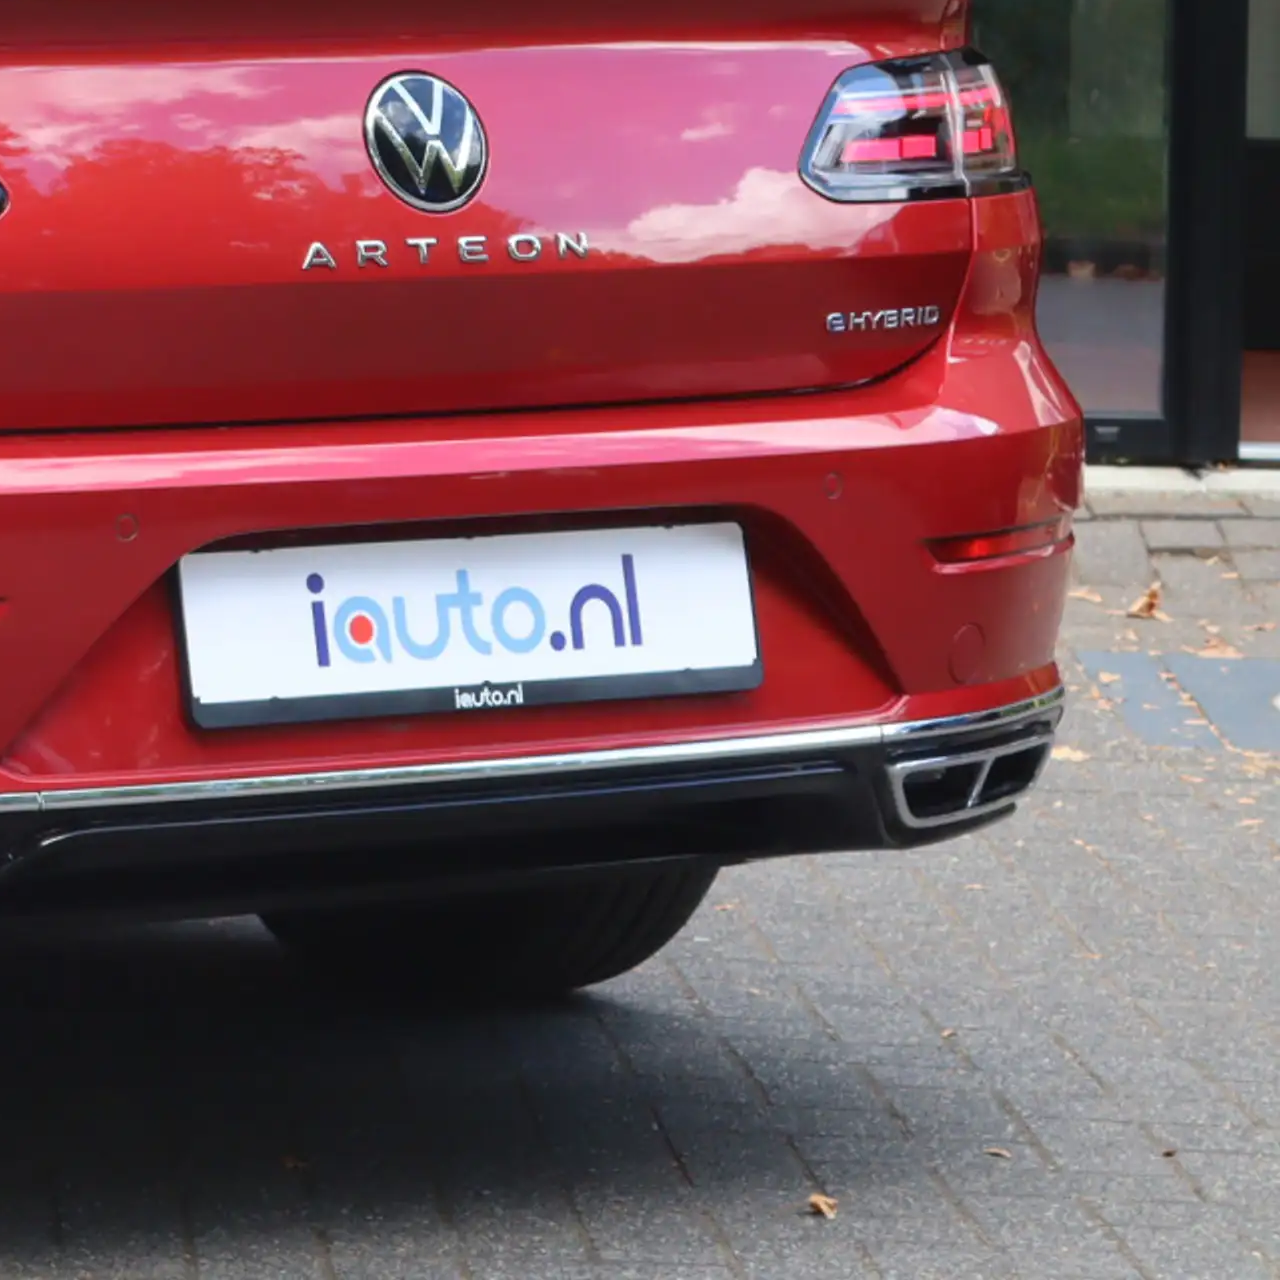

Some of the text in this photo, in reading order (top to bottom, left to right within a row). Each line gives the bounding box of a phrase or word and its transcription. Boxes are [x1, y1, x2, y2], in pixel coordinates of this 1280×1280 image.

[301, 231, 589, 270] ARTEON
[306, 553, 644, 668] iauto.nl
[454, 681, 524, 710] iauto.nl
